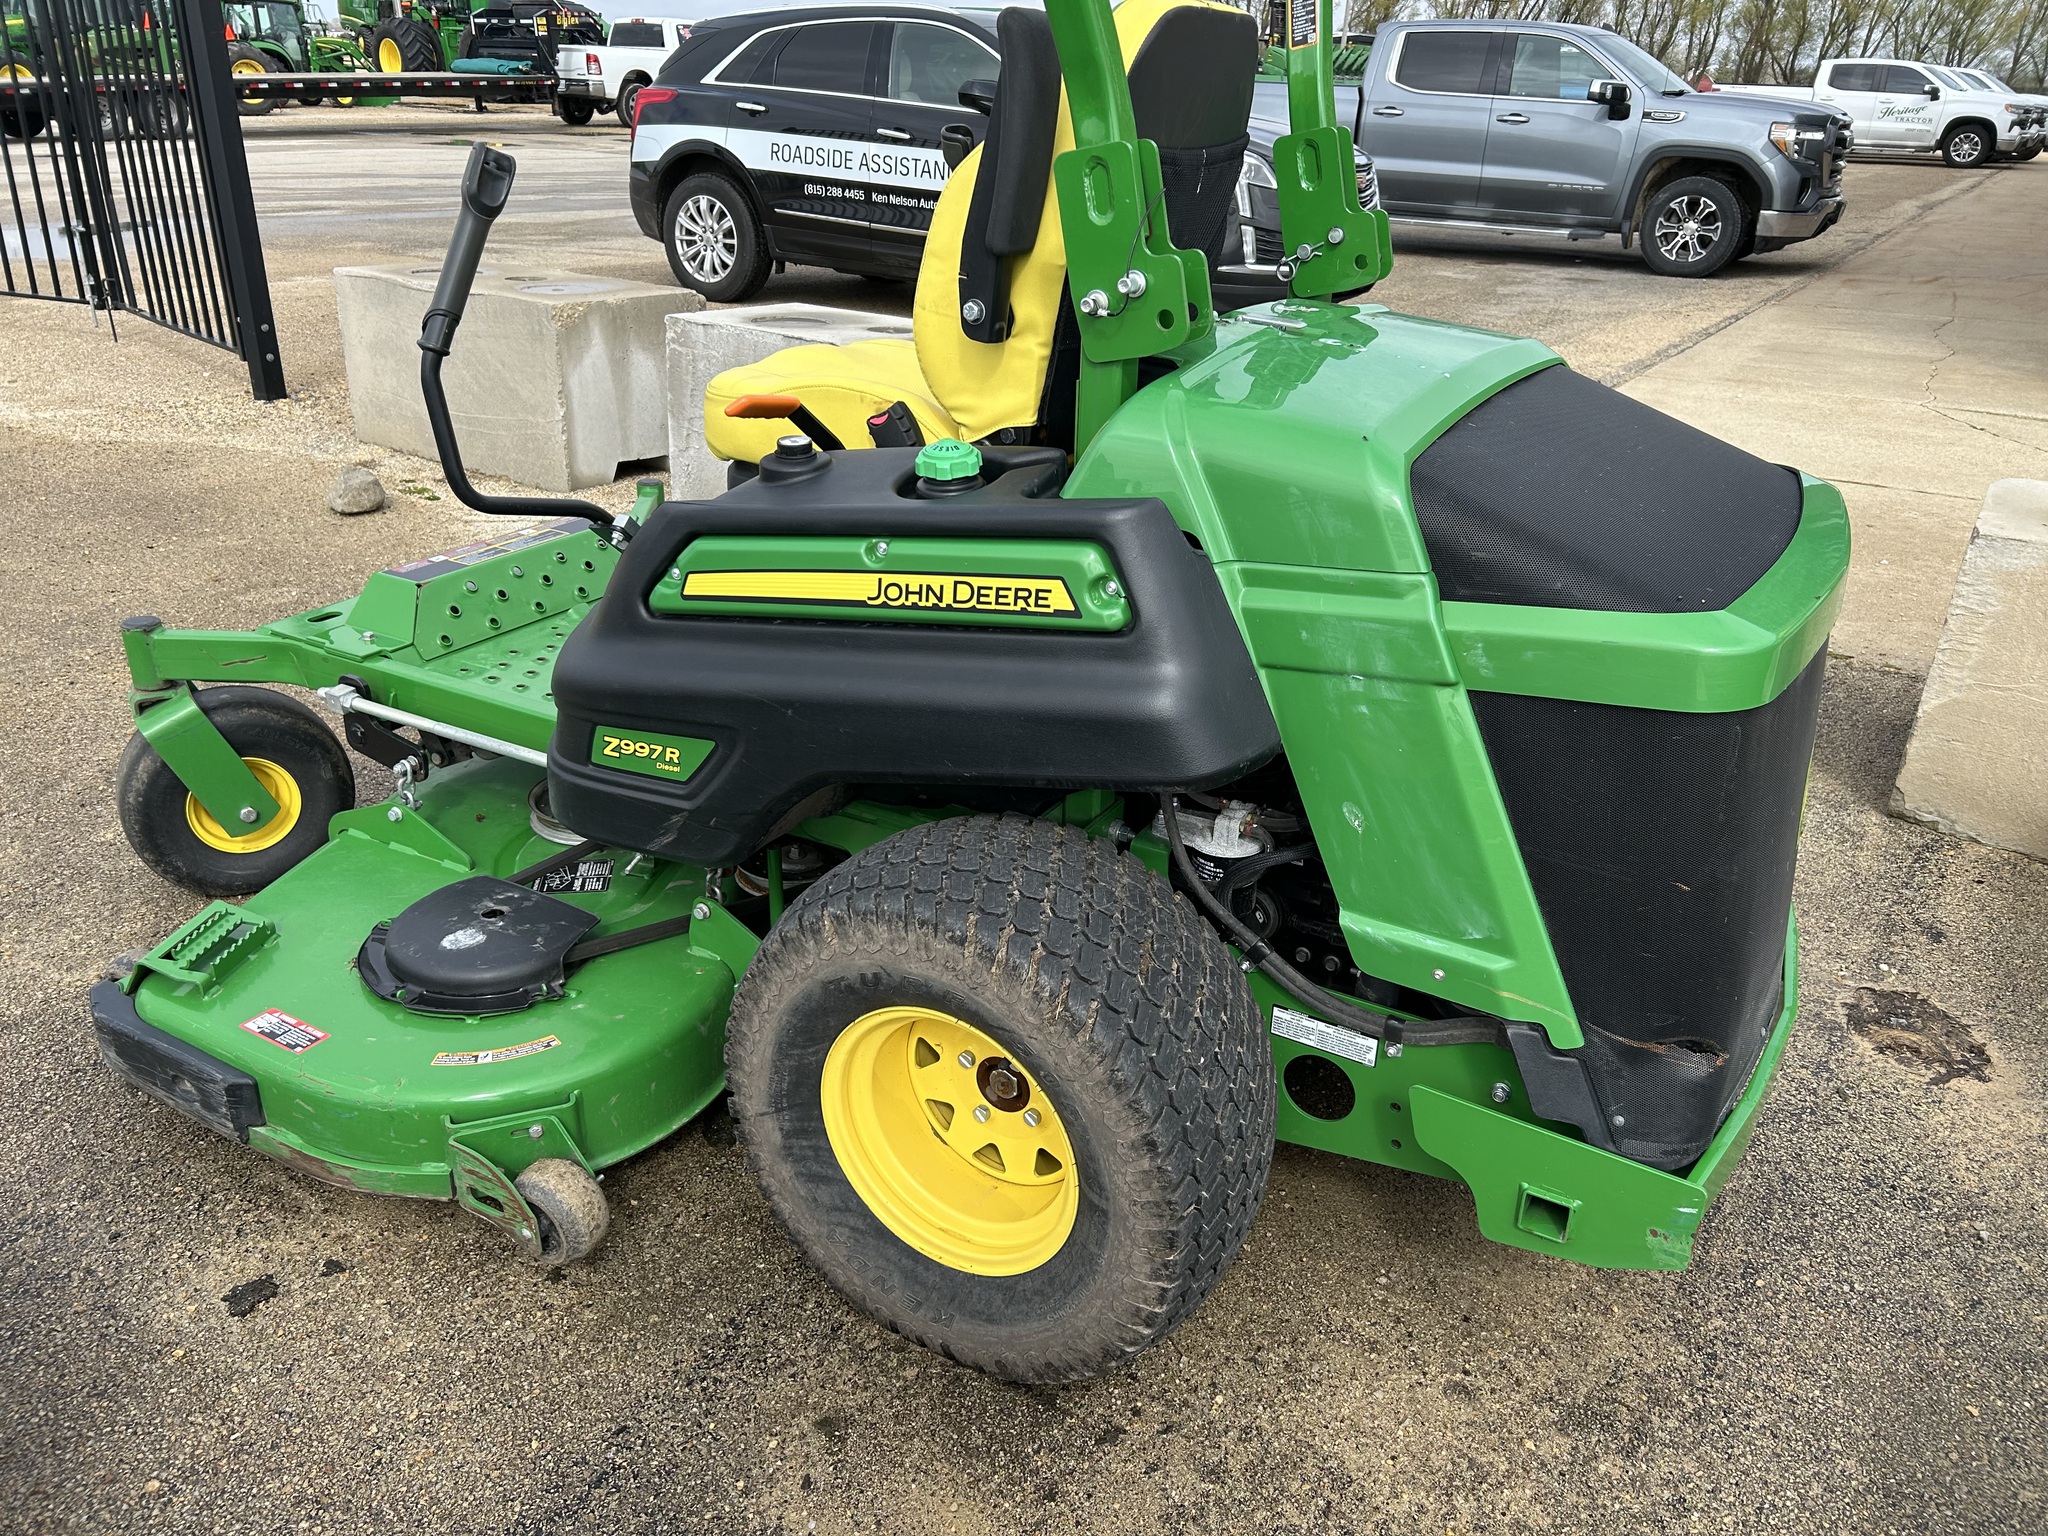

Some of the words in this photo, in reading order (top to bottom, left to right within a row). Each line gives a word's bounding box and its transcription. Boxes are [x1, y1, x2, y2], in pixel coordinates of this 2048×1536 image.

[1878, 105, 1928, 119] Heritage
[1894, 116, 1933, 124] TRACTOR
[770, 142, 853, 170] ROADSIDE
[858, 152, 951, 180] ASSISTAN
[804, 183, 826, 198] (815)
[826, 186, 843, 198] 288
[844, 188, 865, 201] 4455
[872, 191, 888, 204] Ken
[889, 194, 918, 208] Nelson
[867, 577, 944, 604] JOHN
[952, 580, 1052, 609] DEERE
[656, 762, 680, 773] Diesel
[826, 1225, 957, 1331] KENDA
